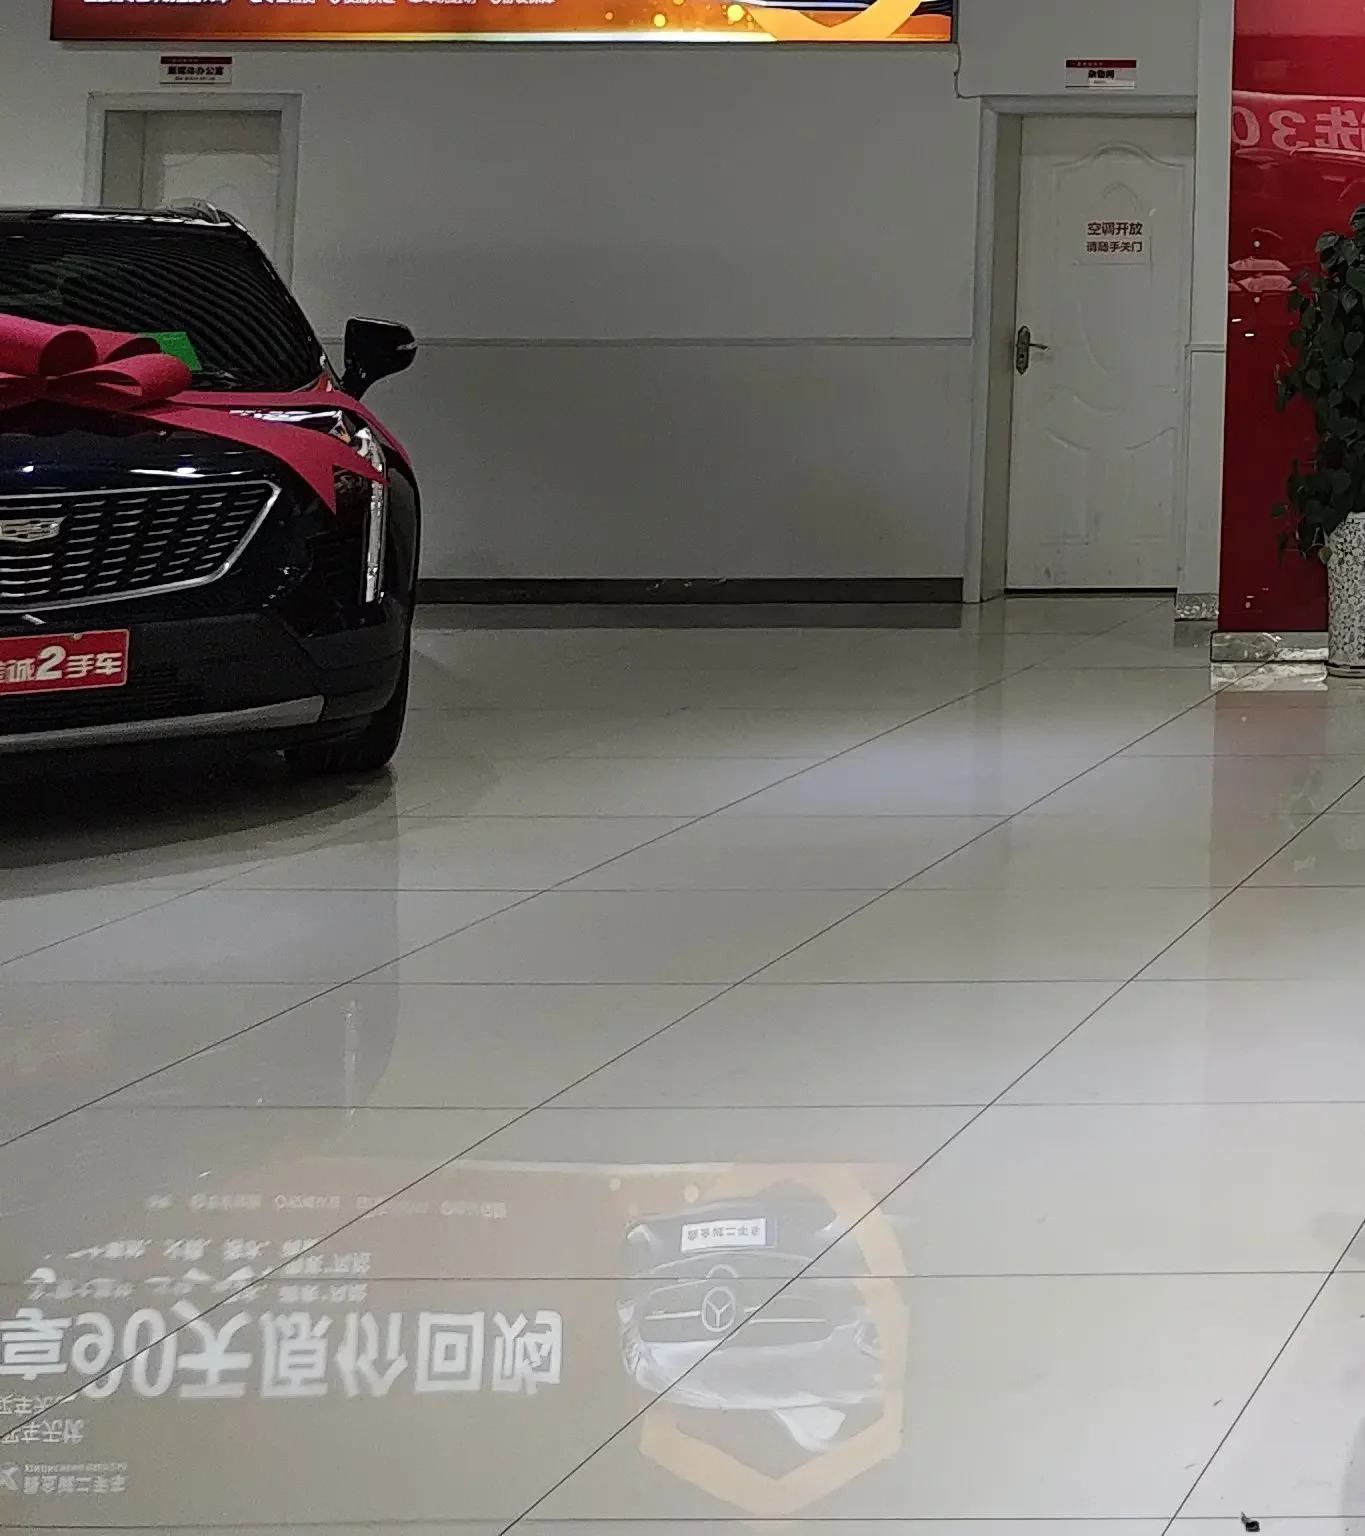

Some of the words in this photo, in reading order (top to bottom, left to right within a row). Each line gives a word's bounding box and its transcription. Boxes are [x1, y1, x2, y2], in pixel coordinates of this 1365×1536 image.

[1086, 221, 1144, 237] 空调开放
[0, 645, 123, 684] 诚2手车
